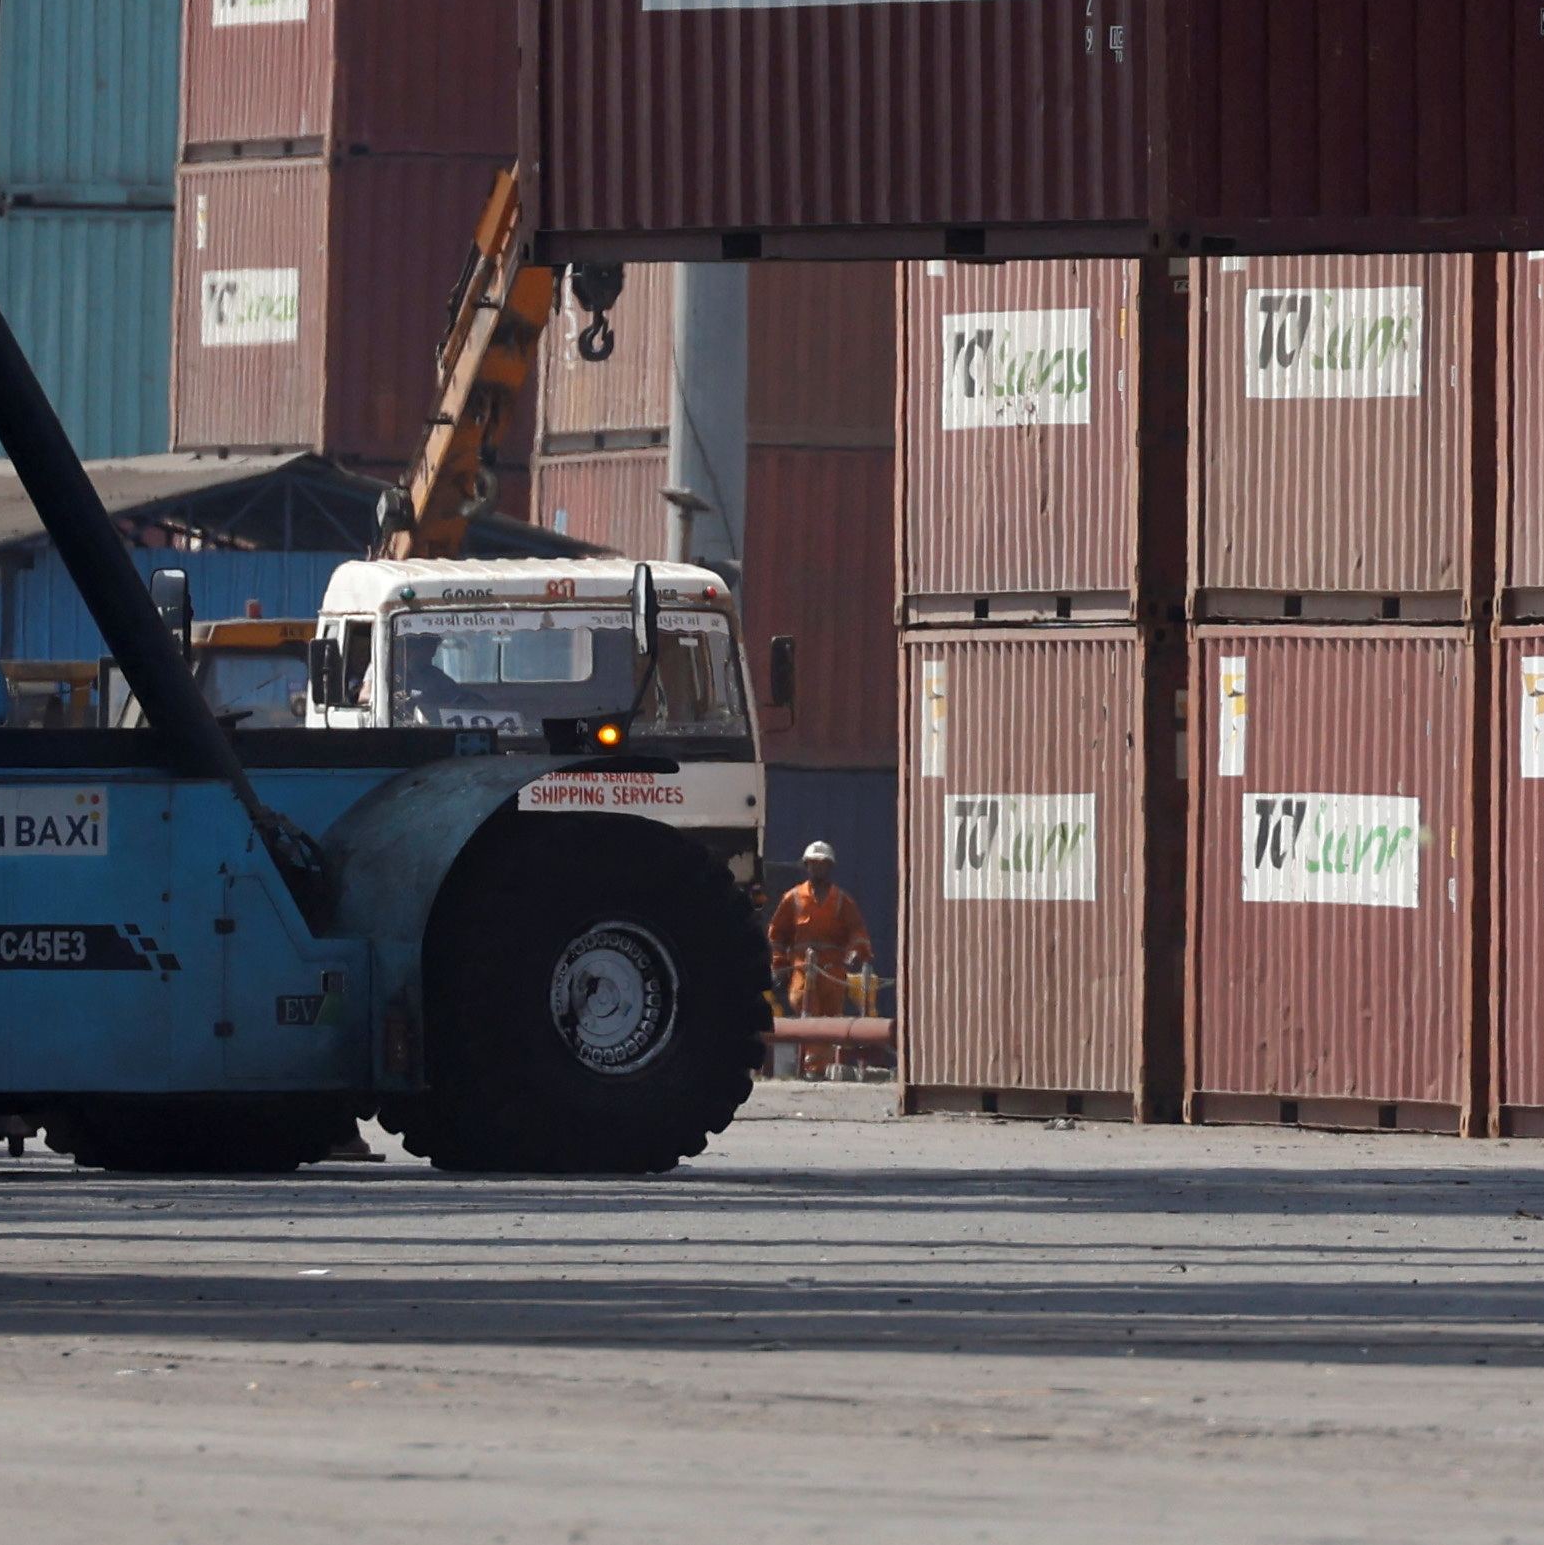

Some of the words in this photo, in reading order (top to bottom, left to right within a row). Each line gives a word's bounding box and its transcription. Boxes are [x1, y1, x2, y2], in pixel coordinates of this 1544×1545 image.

[1084, 26, 1094, 53] 9
[548, 771, 600, 784] SHIPPING
[603, 772, 655, 785] SERVICES
[530, 786, 605, 804] SHIPPING
[612, 786, 683, 804] SERVICES
[284, 998, 318, 1022] EV
